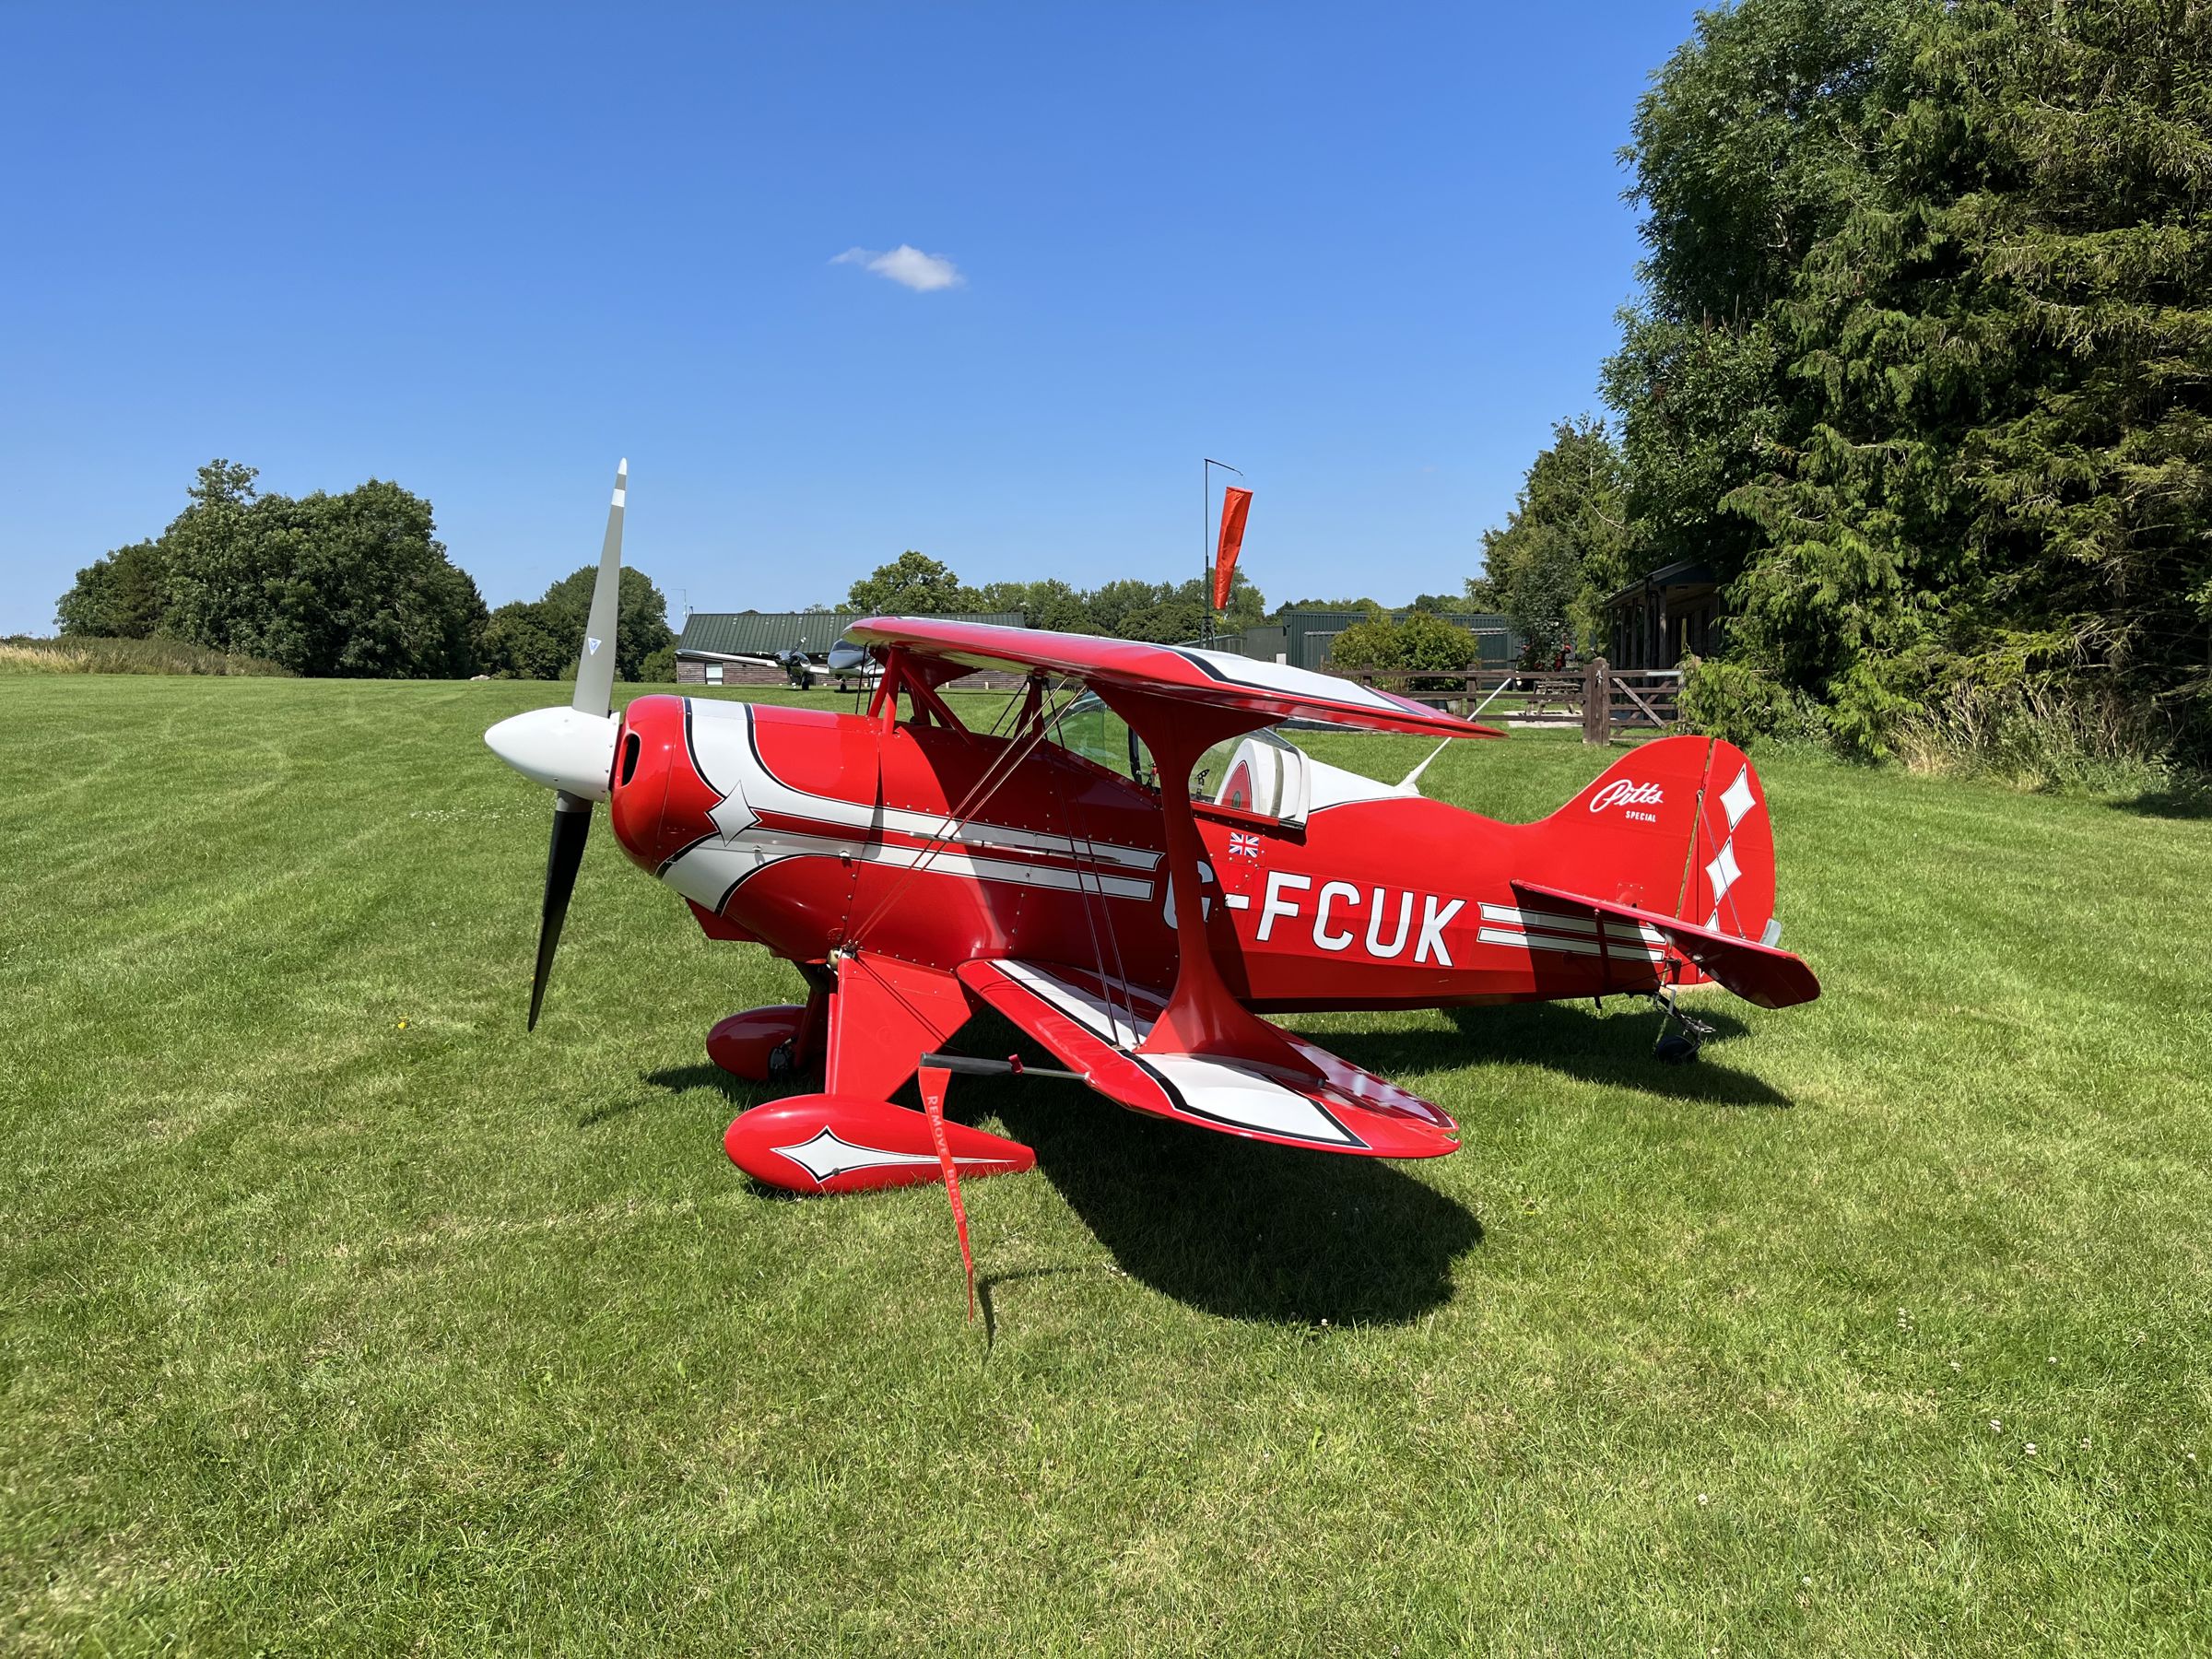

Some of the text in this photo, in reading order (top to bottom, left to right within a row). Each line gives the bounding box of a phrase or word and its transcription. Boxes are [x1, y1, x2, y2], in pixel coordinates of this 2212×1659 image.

[1589, 779, 1664, 813] Pitts
[1625, 810, 1656, 822] SPECIAL
[927, 1095, 947, 1157] REMOVE
